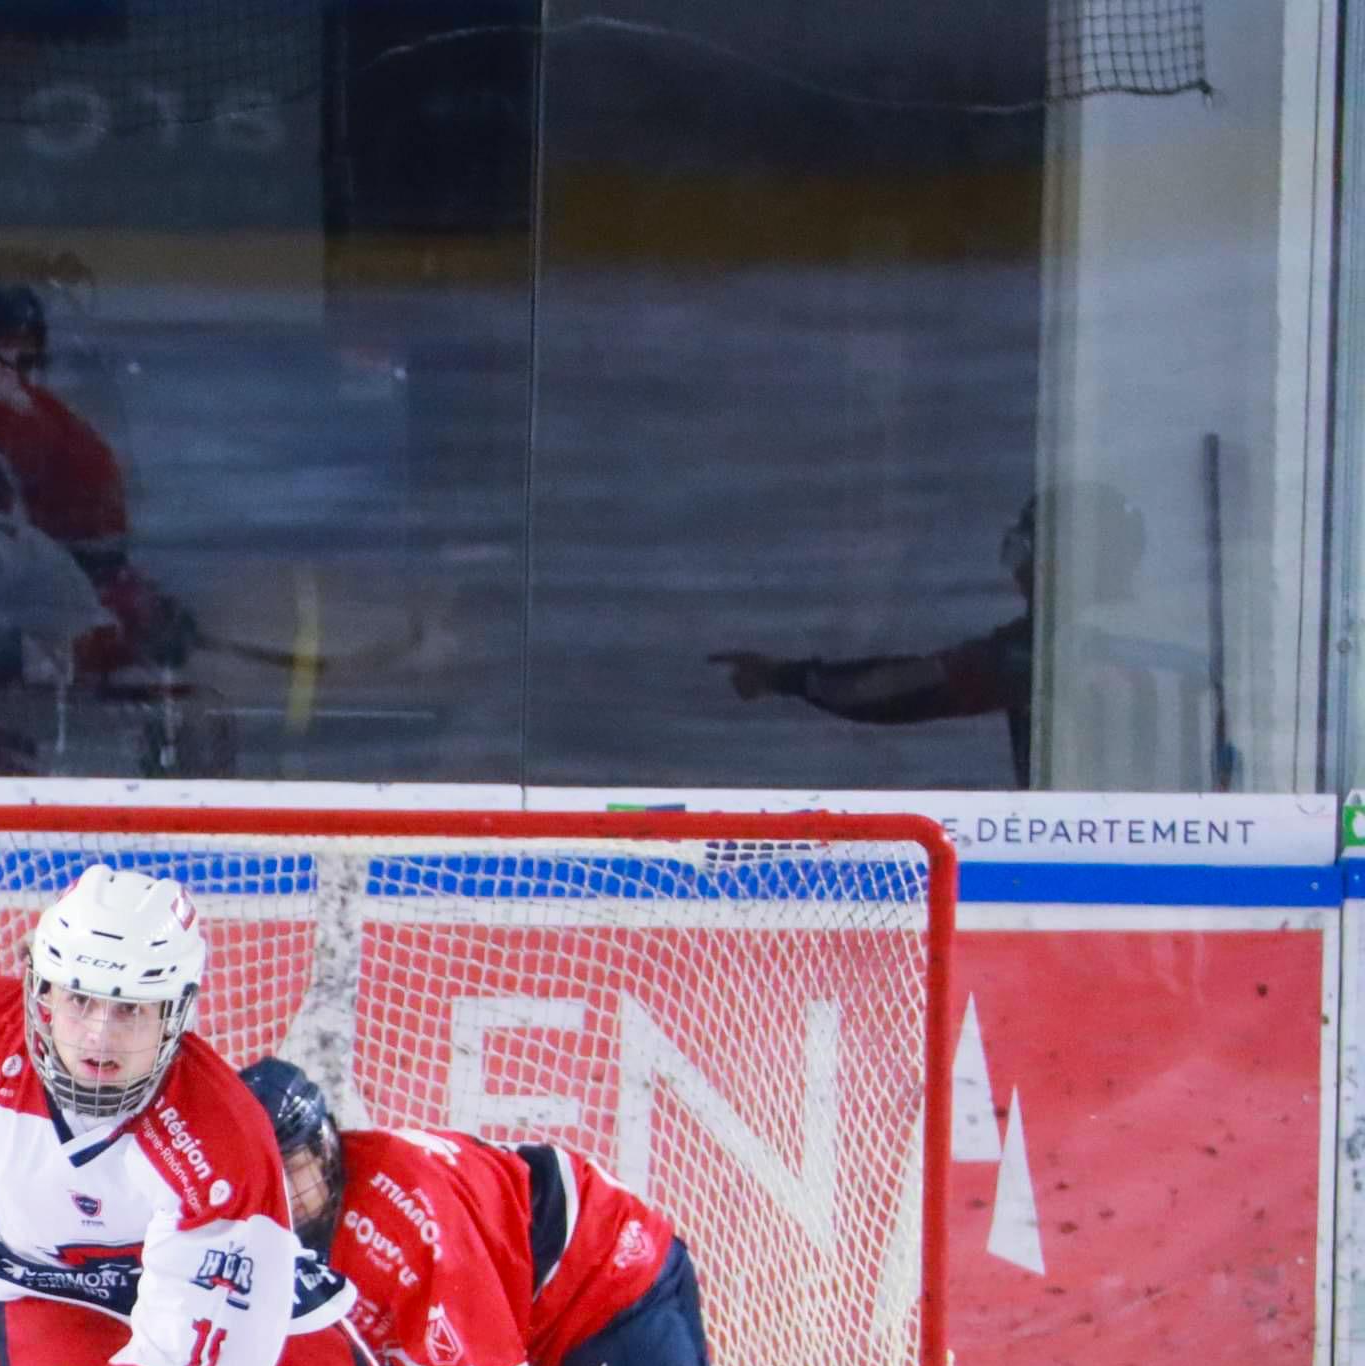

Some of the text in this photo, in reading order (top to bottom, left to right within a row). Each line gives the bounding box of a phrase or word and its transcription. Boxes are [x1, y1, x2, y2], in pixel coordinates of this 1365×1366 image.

[976, 812, 1256, 845] DÉPARTEMENT
[75, 954, 128, 972] CCM
[159, 1106, 213, 1180] Région
